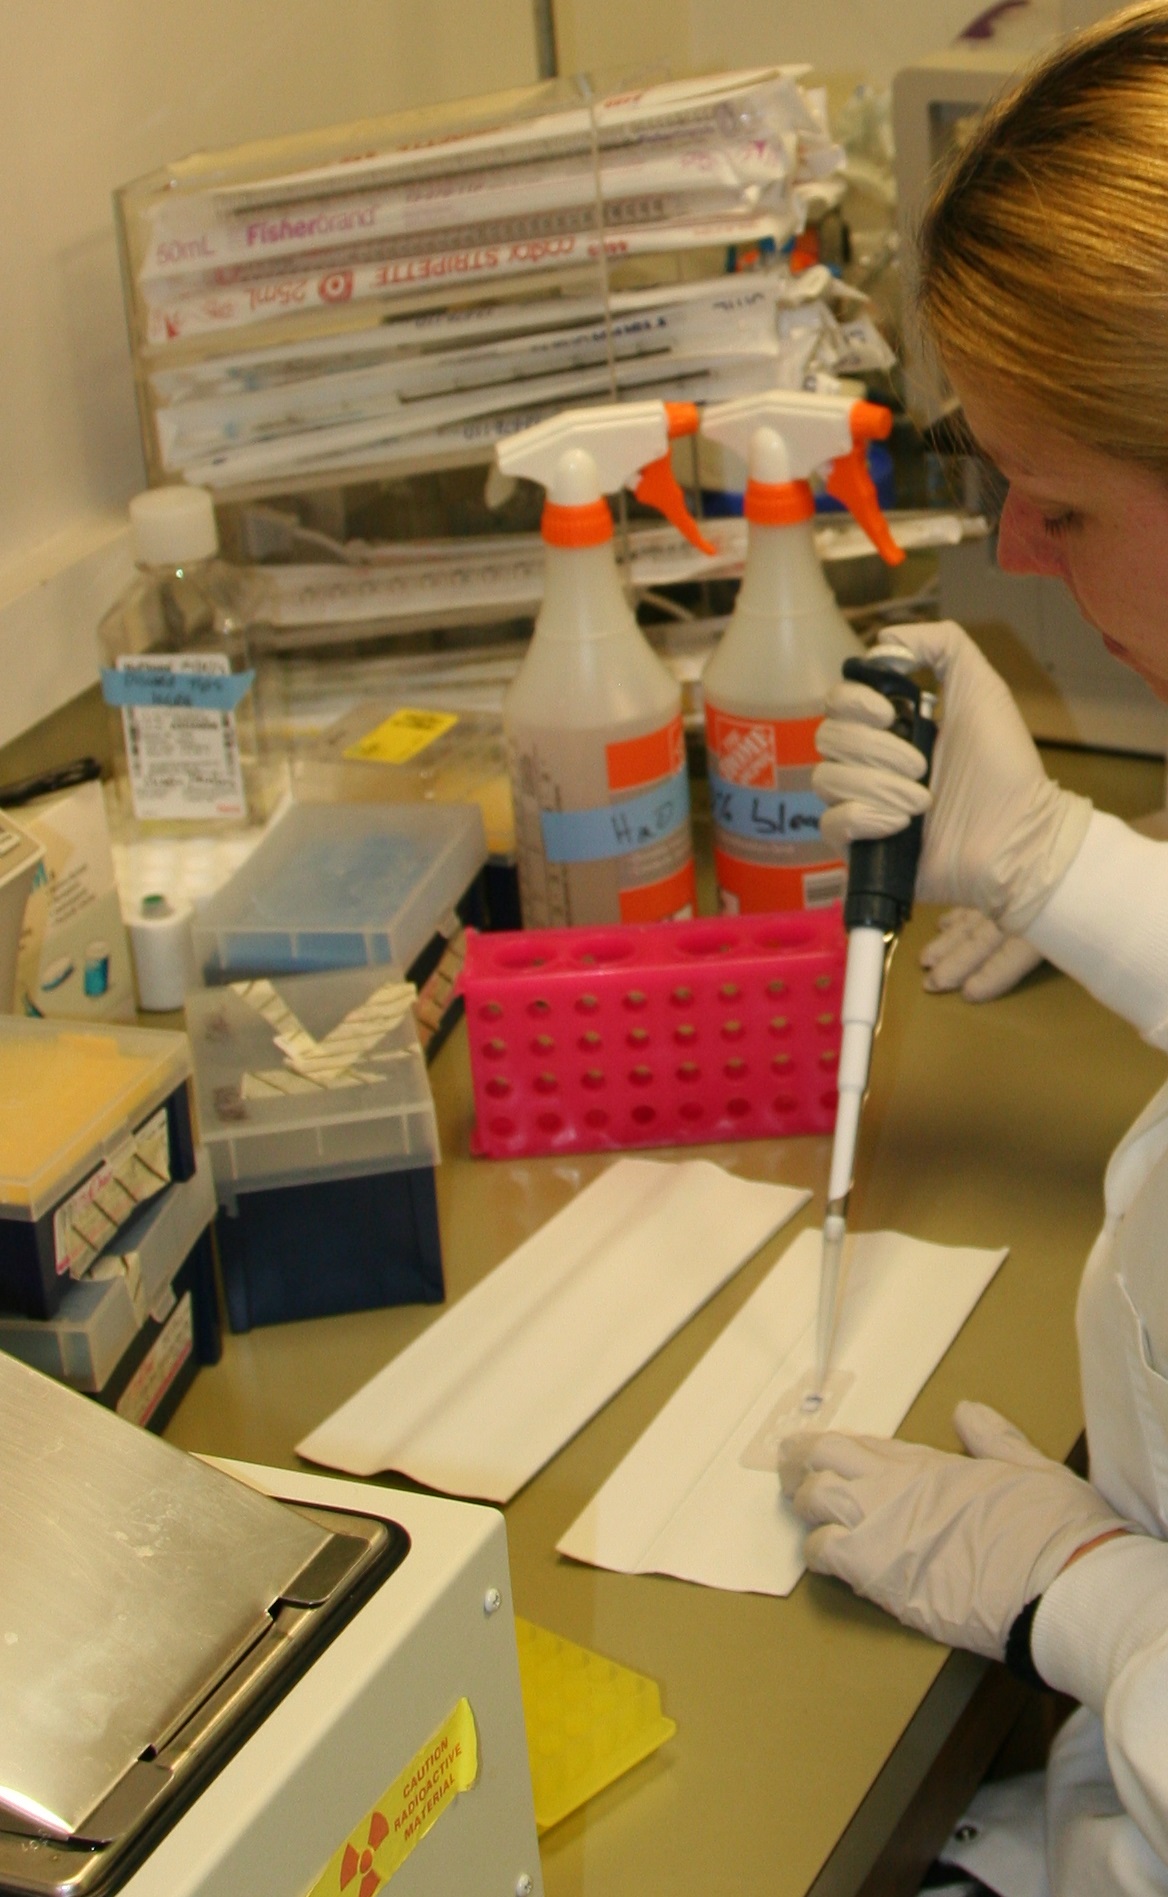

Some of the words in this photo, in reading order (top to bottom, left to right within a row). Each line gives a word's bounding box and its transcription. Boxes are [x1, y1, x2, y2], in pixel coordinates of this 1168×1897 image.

[246, 204, 379, 247] Fisherbrand
[375, 249, 500, 286] STRIPETTE
[393, 1742, 463, 1832] RADIOACTIVE
[403, 1736, 449, 1799] CAUTION
[403, 1773, 456, 1842] MATERIAL
